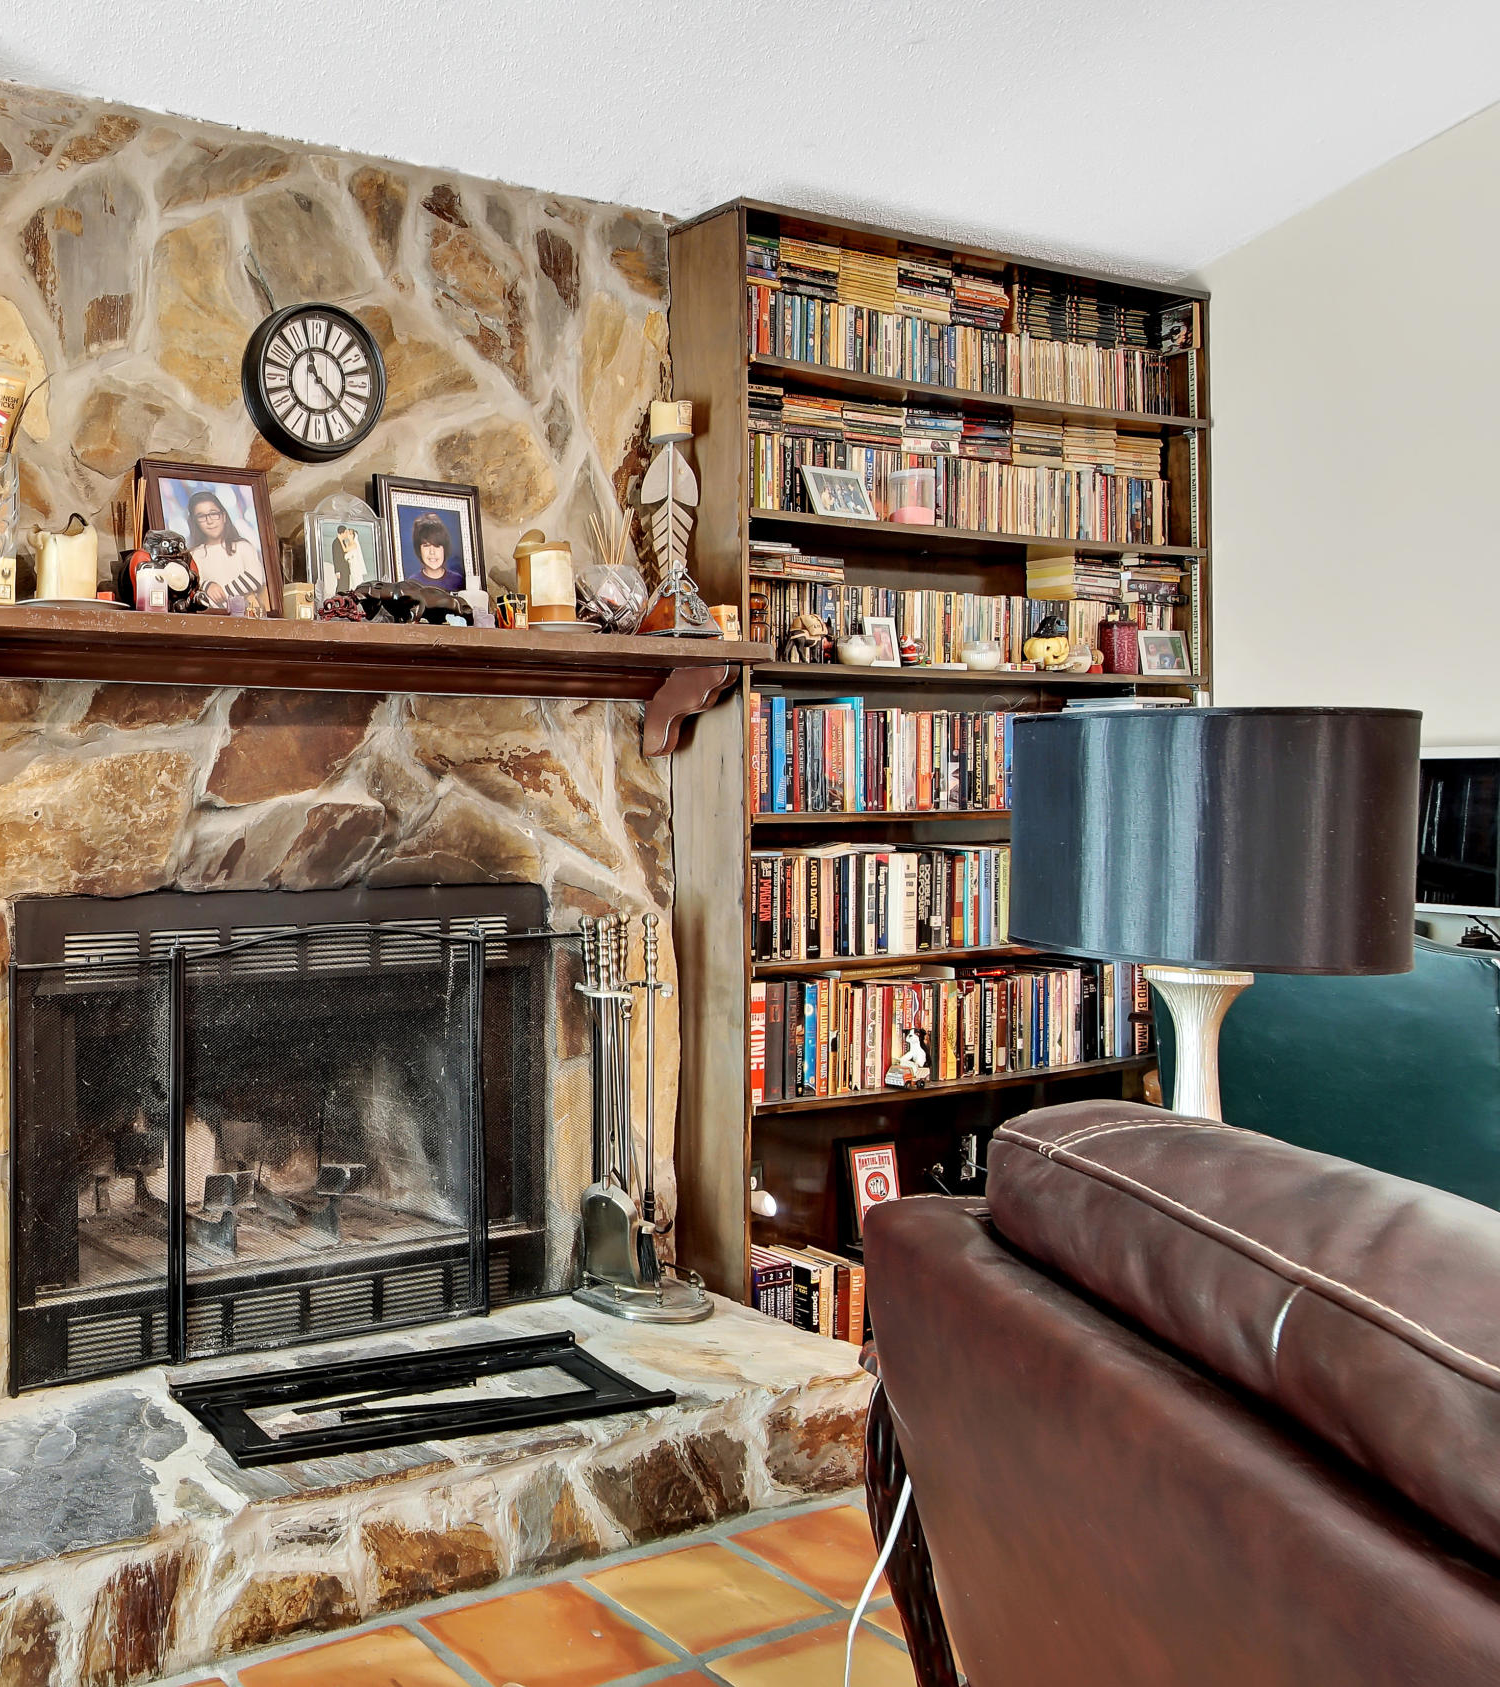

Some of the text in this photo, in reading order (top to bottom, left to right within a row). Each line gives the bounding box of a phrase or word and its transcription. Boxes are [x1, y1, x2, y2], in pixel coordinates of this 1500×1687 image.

[311, 321, 322, 341] 12
[271, 344, 291, 364] 10
[315, 419, 321, 440] 6
[762, 1275, 766, 1283] 1
[778, 1272, 783, 1280] 3
[786, 1270, 791, 1278] 4
[812, 1290, 820, 1327] Spanish
